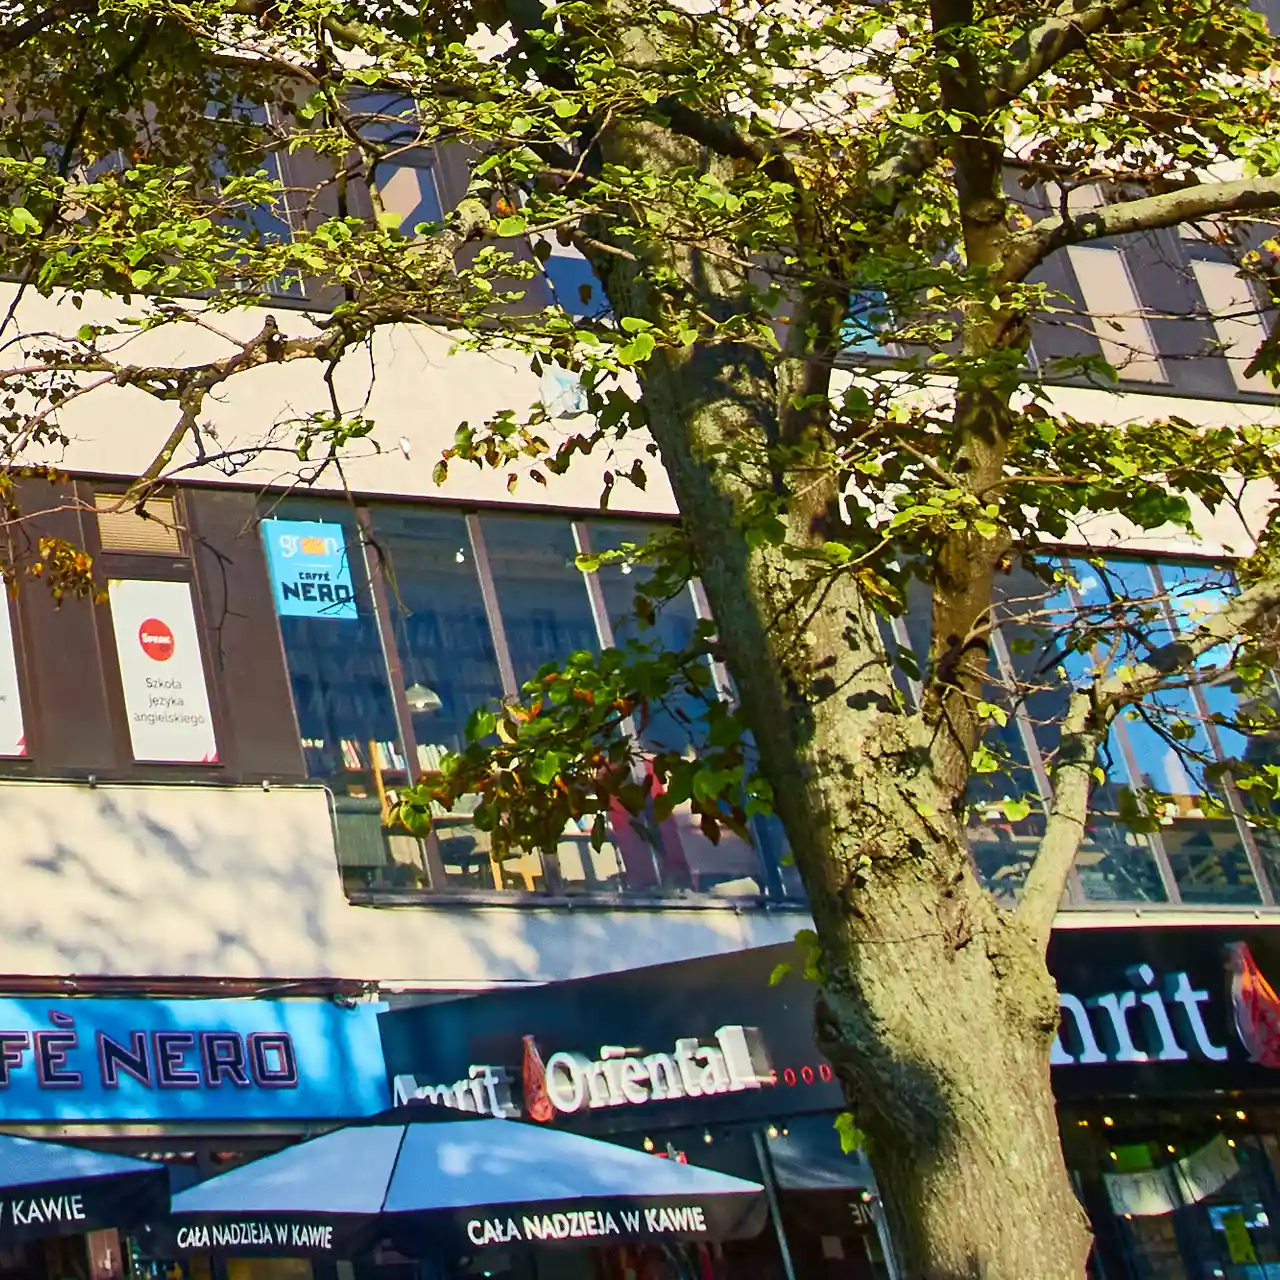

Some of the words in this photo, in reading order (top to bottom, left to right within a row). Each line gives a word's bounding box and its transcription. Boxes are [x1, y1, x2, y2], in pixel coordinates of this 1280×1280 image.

[281, 581, 351, 603] NERO
[145, 677, 183, 690] Szkoła
[133, 712, 205, 727] angielskiego
[95, 1029, 300, 1090] NERO
[545, 1025, 764, 1114] Oriental
[11, 1194, 87, 1225] KAWIE
[177, 1225, 210, 1249] CAŁA
[212, 1222, 273, 1245] NADZIEJA
[274, 1223, 288, 1245] W
[292, 1224, 333, 1249] KAWIE
[467, 1217, 522, 1245] CAŁA
[522, 1210, 620, 1241] NADZIEJA
[620, 1210, 641, 1233] W
[644, 1206, 708, 1233] KAWIE
